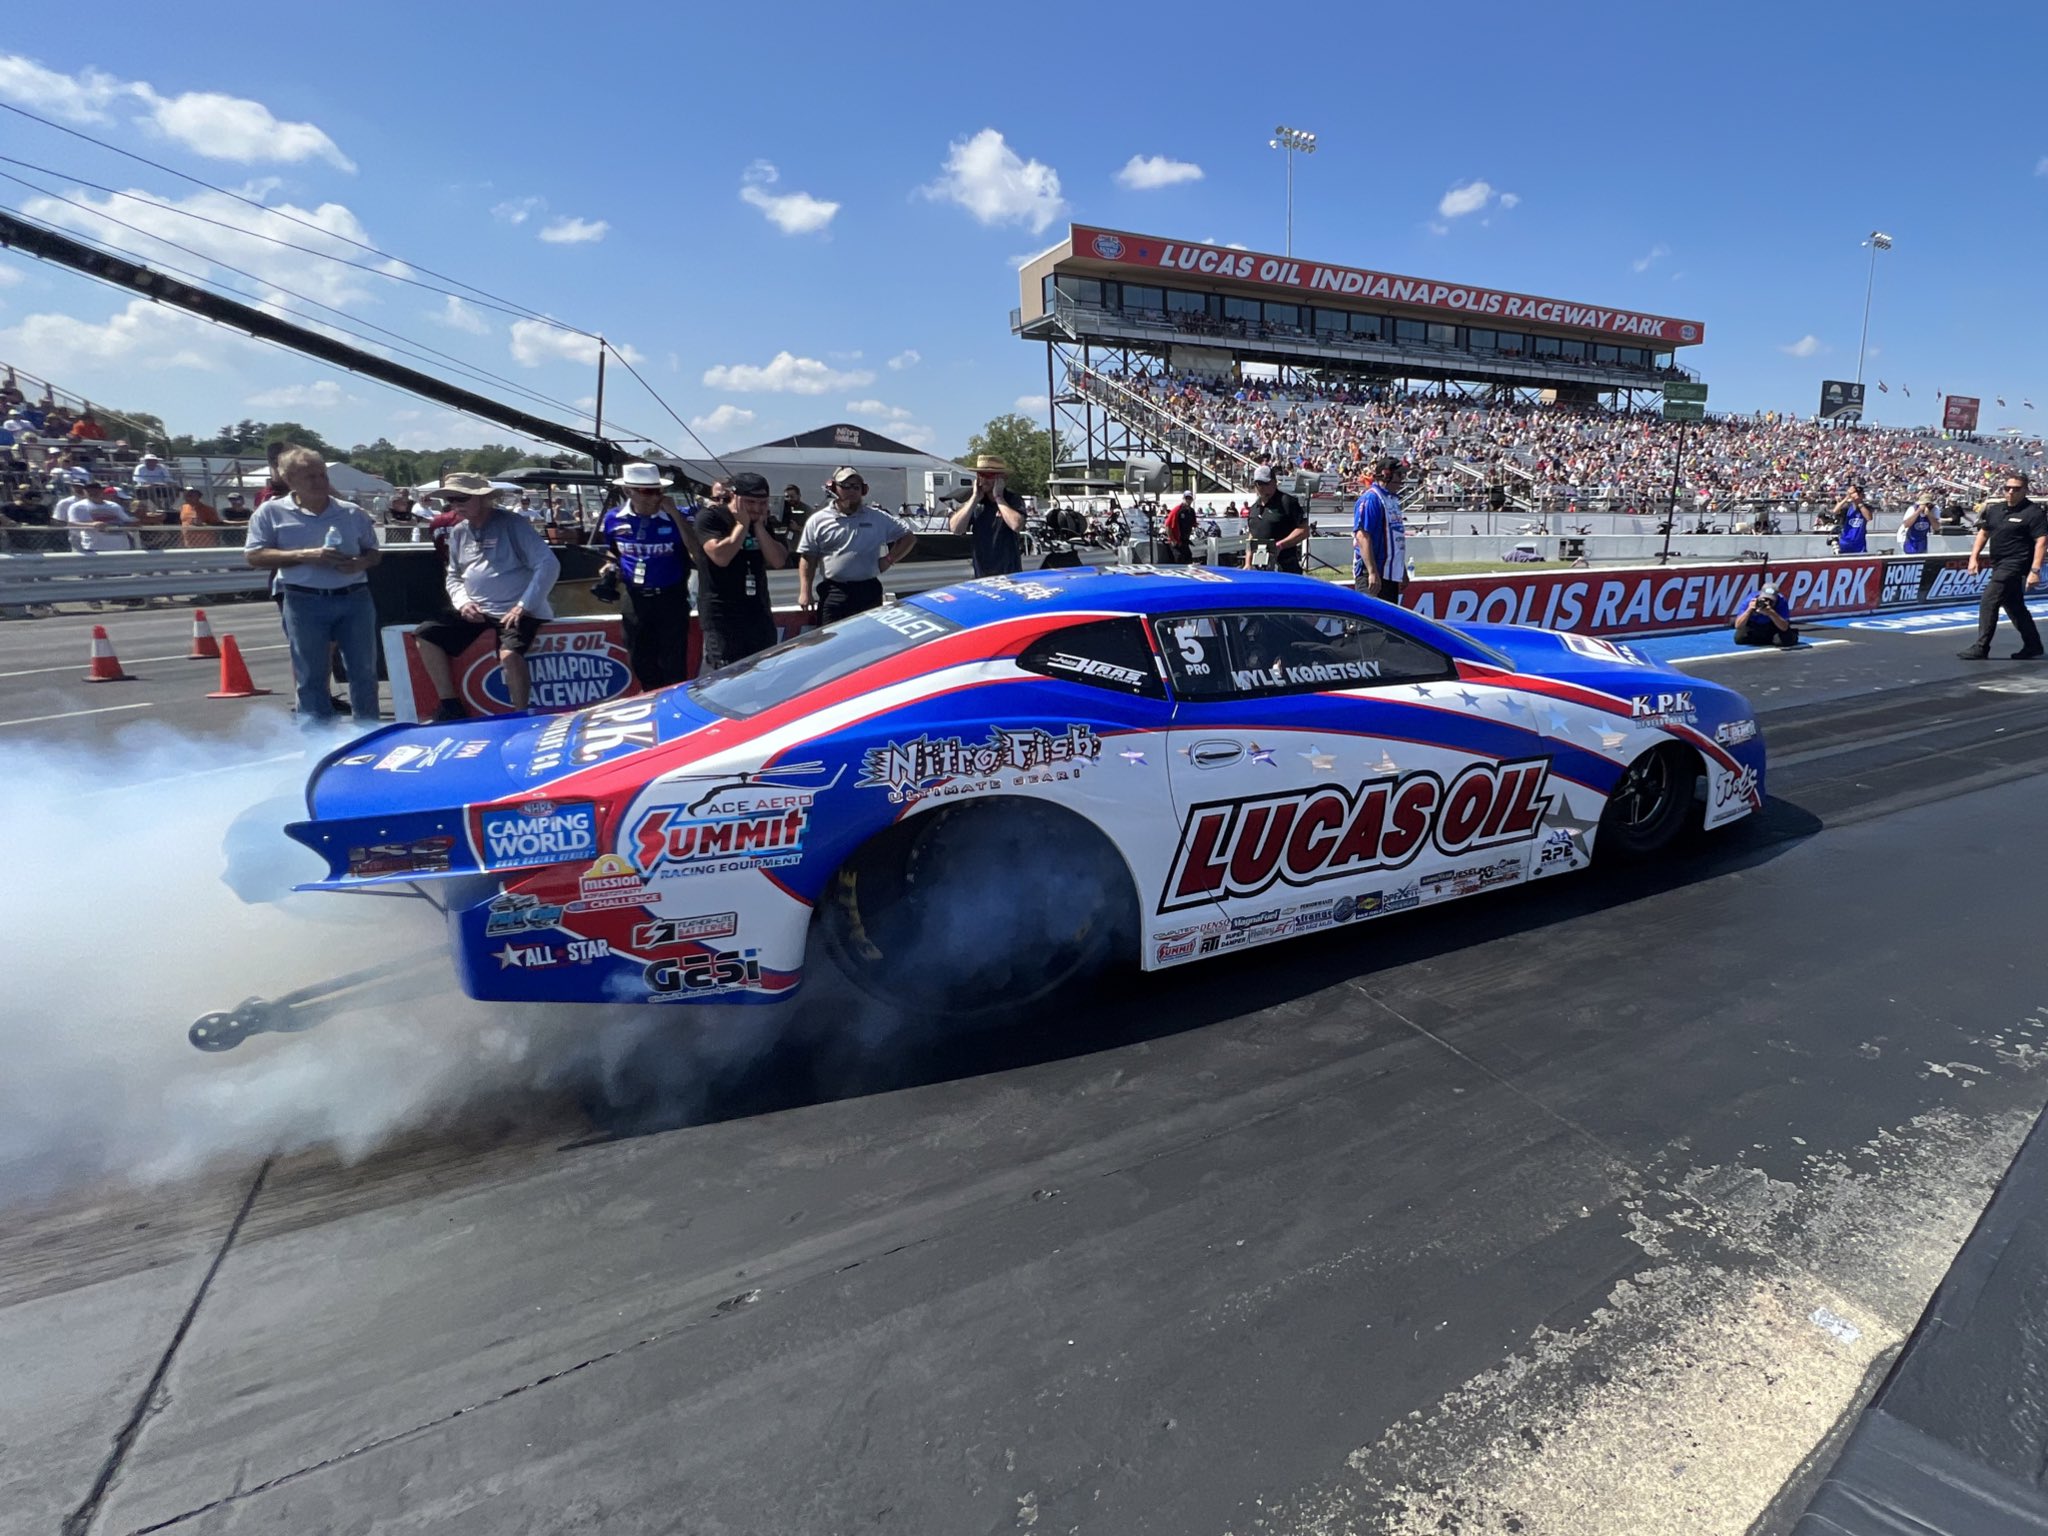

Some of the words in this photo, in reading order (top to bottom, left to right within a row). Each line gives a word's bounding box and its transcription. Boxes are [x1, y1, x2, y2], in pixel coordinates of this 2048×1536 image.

[1159, 244, 1255, 278] LUCAS
[1259, 259, 1302, 285] OIL
[1309, 266, 1503, 313] INDIANAPOLIS
[1504, 297, 1613, 329] RACEWAY
[1612, 314, 1667, 338] PARK
[1884, 563, 1925, 585] HOME
[1401, 581, 1588, 630] APOLIS
[1590, 571, 1788, 628] RACEWAY
[1788, 566, 1875, 610] PARK
[1881, 585, 1897, 603] OF
[1899, 584, 1920, 600] THE
[1938, 582, 1988, 597] BROKE
[531, 636, 565, 653] CAS
[573, 635, 606, 651] OIL
[1174, 627, 1205, 663] 5
[502, 655, 614, 684] IANAPOLIS
[1185, 663, 1211, 676] PRO
[1231, 670, 1286, 690] KYLE
[1286, 660, 1381, 684] KORETSKY
[528, 679, 610, 707] ACEWAY
[1631, 692, 1695, 717] K.P.K.
[992, 725, 1101, 770] Fish
[888, 779, 1002, 803] ULTIMATE
[707, 800, 750, 815] ACE
[755, 794, 813, 811] AERO
[487, 813, 589, 838] CAMPING
[1168, 776, 1438, 906] LUCAS
[1438, 760, 1546, 852] OIL
[490, 830, 591, 858] WORLD
[1541, 846, 1573, 862] RPE
[660, 864, 715, 879] RACING
[719, 855, 801, 873] EQUIPMENT
[590, 894, 659, 909] CHALLENGE
[678, 914, 733, 928] FEATHER-LITE
[678, 922, 733, 936] BATTERIES
[1200, 919, 1230, 932] DENSO
[1221, 937, 1246, 948] DAMPER
[1225, 930, 1245, 940] SUPER
[525, 946, 557, 967] ALL
[567, 939, 610, 961] STAR
